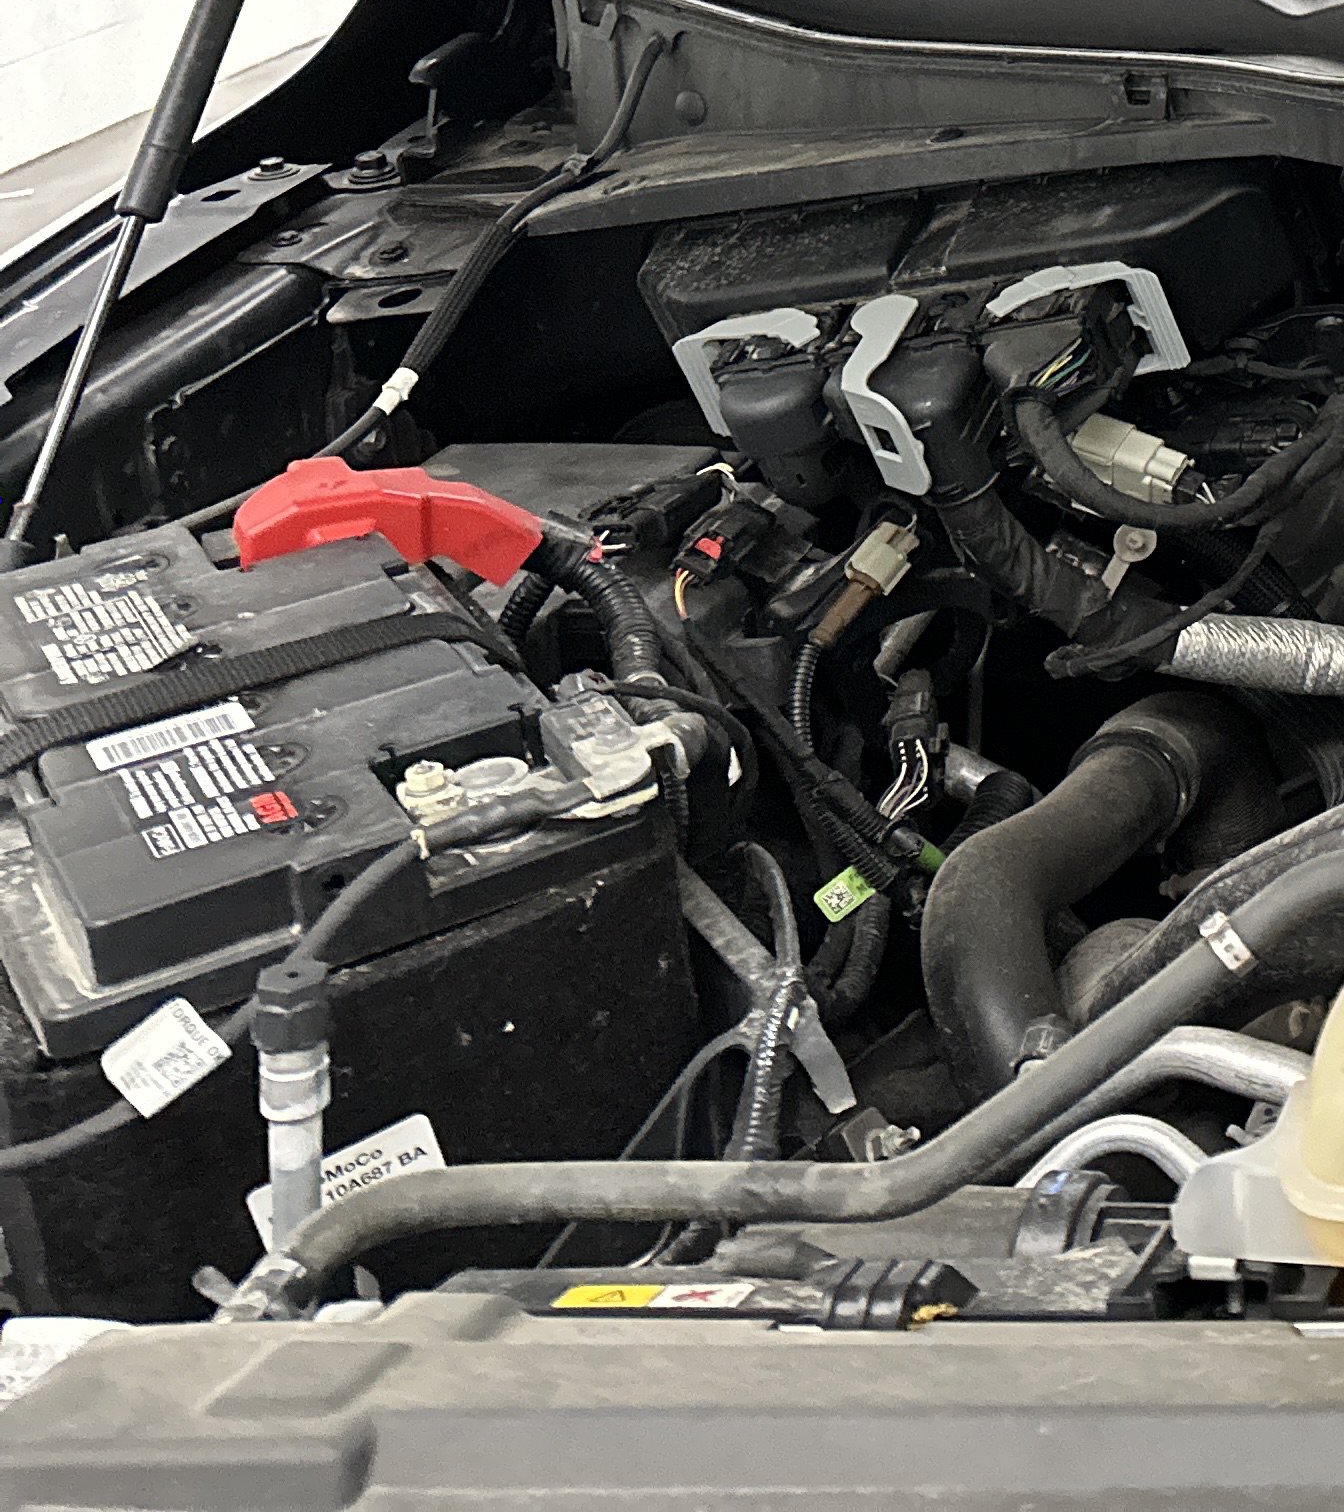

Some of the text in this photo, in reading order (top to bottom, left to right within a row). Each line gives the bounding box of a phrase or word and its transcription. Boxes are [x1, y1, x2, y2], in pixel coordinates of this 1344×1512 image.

[168, 1002, 211, 1046] TORQUE
[320, 1147, 384, 1185] MoCo
[397, 1144, 429, 1168] BA
